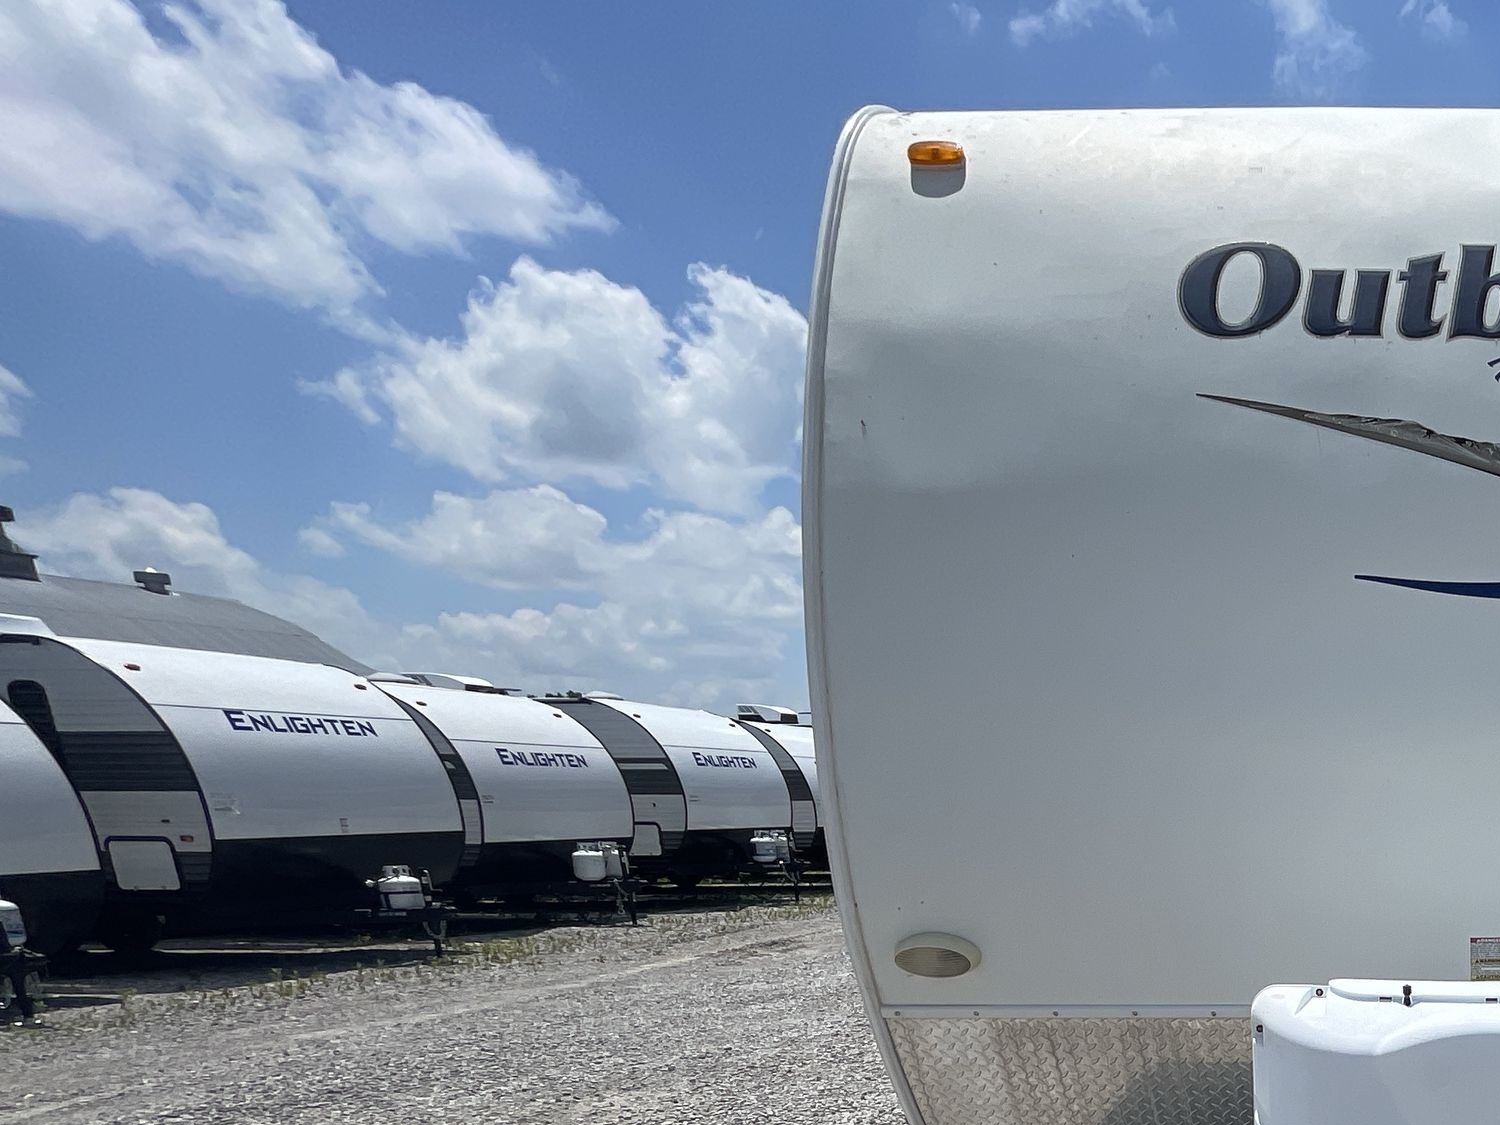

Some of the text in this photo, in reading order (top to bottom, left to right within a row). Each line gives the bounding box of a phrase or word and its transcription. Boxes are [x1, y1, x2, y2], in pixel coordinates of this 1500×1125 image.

[222, 709, 379, 737] ENLIGHTEN
[494, 747, 589, 768] ENLIGHTEN
[691, 752, 758, 769] ENLIGHTEN
